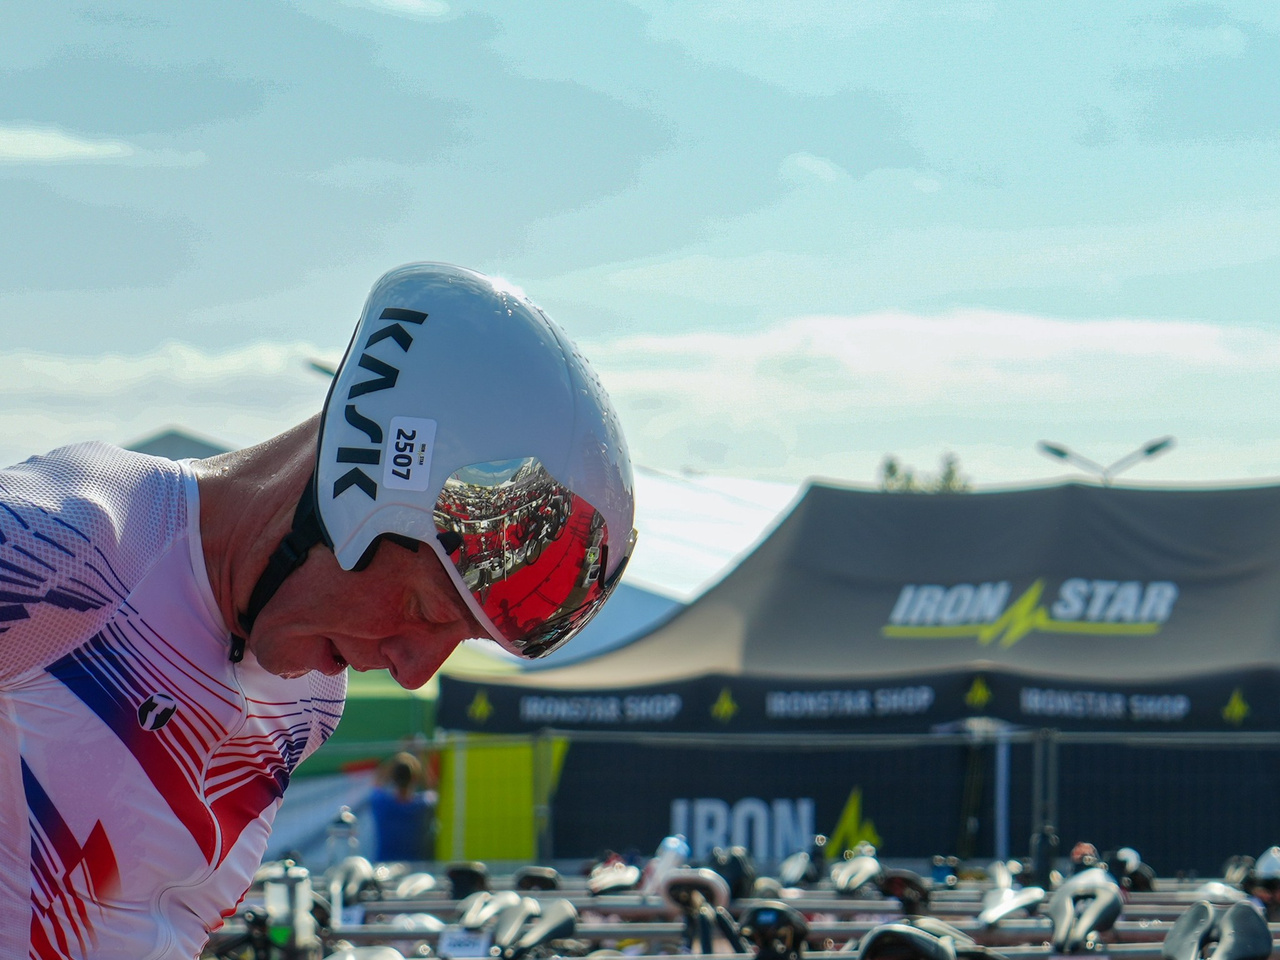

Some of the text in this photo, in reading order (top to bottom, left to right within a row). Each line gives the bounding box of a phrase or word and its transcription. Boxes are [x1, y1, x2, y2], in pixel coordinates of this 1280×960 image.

[333, 307, 428, 501] KASK
[391, 428, 417, 481] 2507
[888, 577, 1180, 626] IRON STAR
[521, 693, 682, 723] IRONSTAR SHOP
[766, 685, 935, 719] IRONSTAR SHOP
[1021, 686, 1191, 722] IRONSTAR SHOP
[671, 797, 816, 866] IRON
